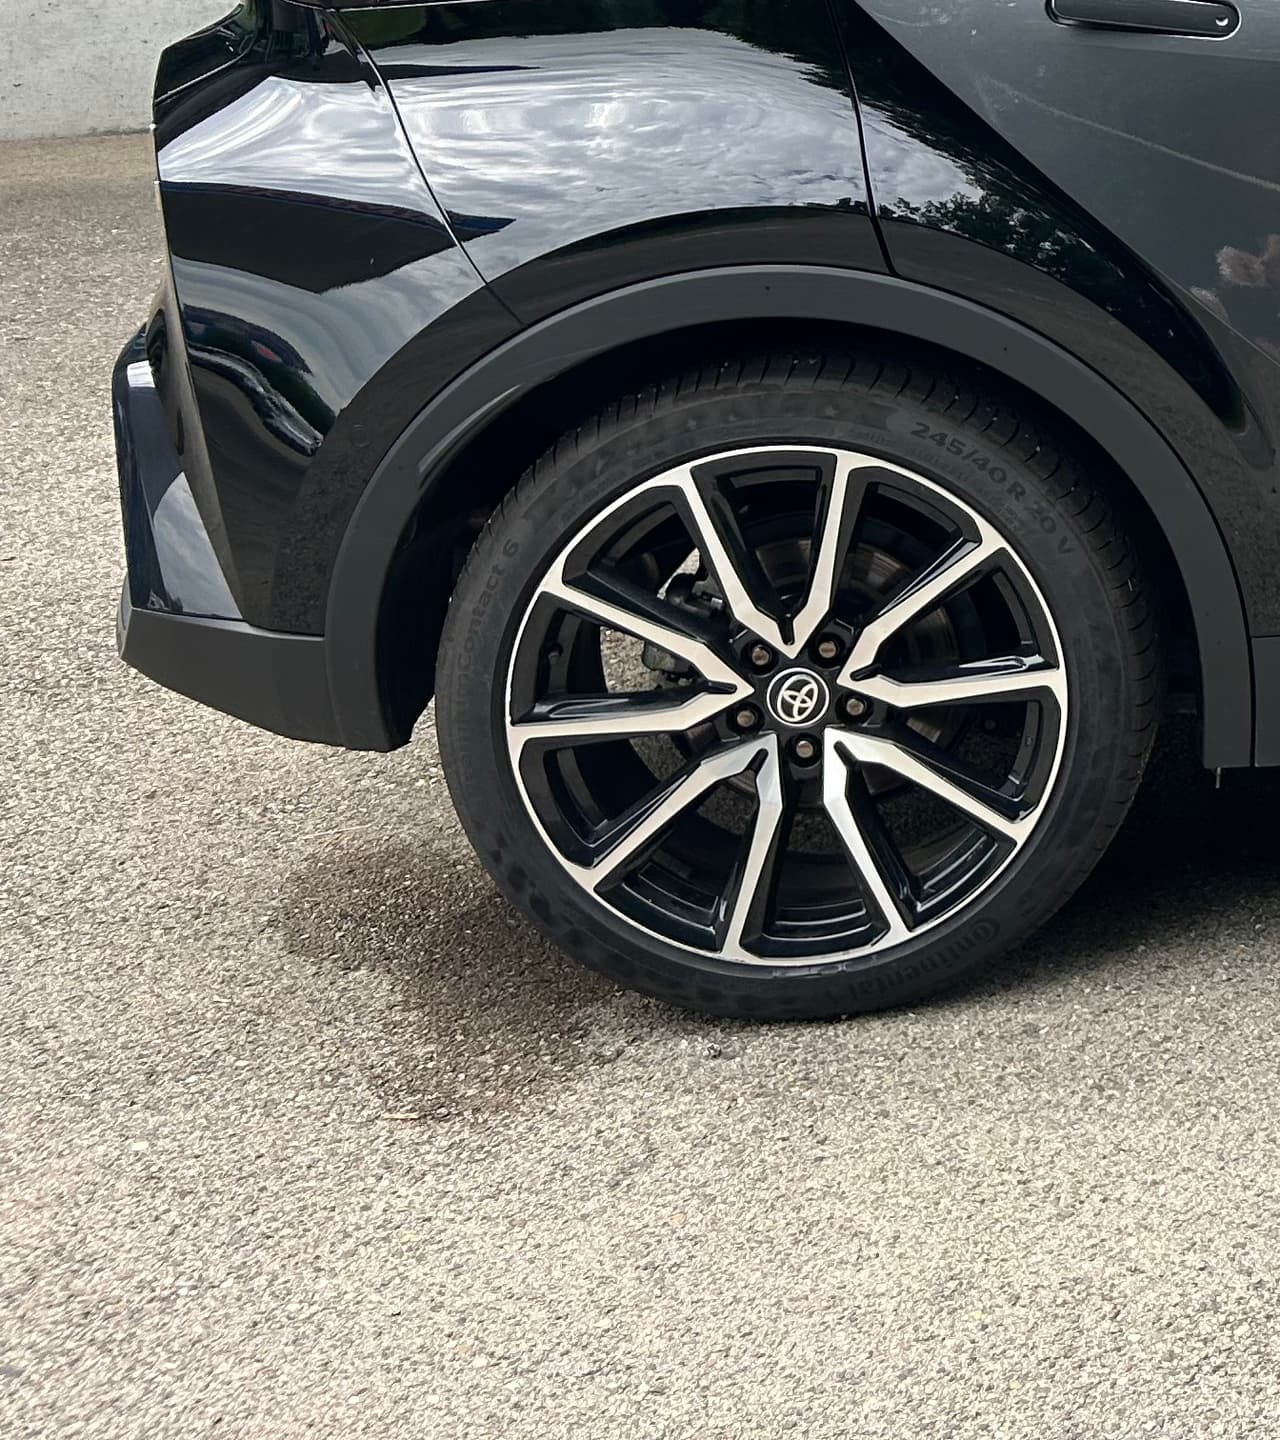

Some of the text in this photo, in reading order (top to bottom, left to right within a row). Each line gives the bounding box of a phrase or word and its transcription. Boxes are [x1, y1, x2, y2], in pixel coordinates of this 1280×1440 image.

[910, 421, 1008, 484] 245/40
[1005, 480, 1027, 503] R
[502, 538, 519, 558] 6
